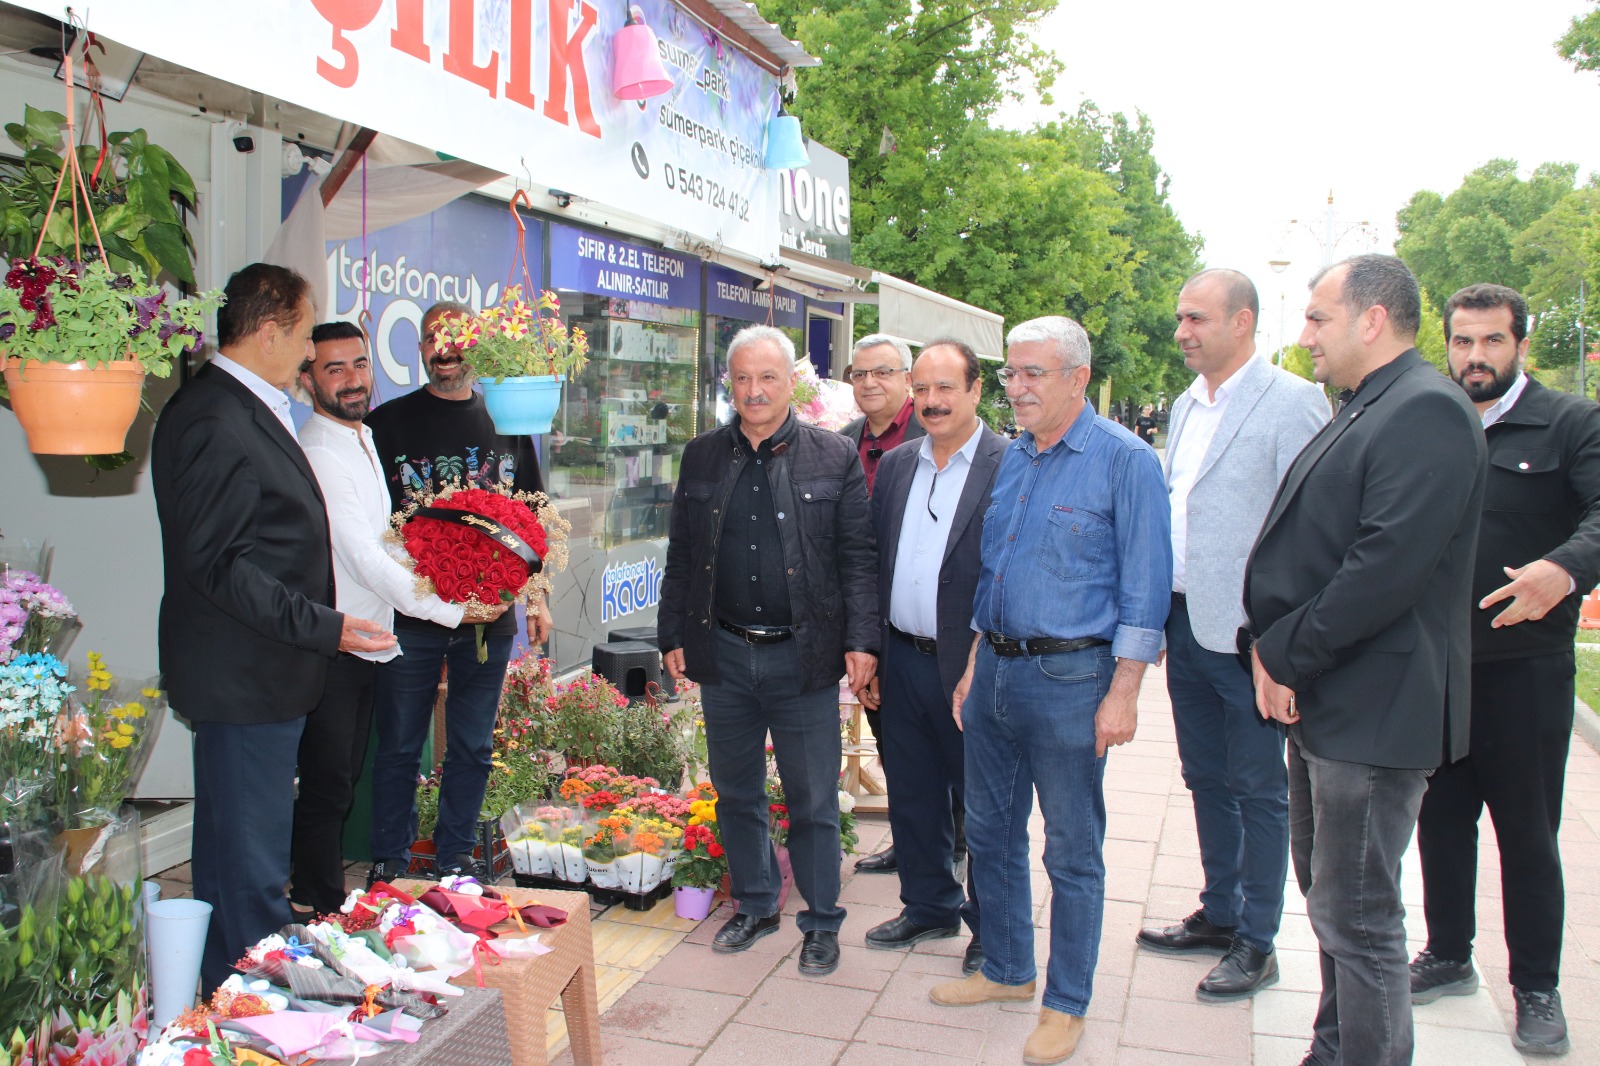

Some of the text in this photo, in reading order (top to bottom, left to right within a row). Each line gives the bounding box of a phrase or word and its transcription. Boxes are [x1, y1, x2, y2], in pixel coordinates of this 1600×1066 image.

[660, 101, 727, 153] sümerpark
[664, 162, 675, 190] 0
[678, 167, 703, 201] 543
[706, 179, 726, 210] 724
[578, 236, 684, 278] SIFIR & 2.EL TELEFON
[800, 231, 828, 258] Servis
[339, 243, 470, 304] telefoncu
[597, 269, 669, 300] ALINIR-SATILIR
[716, 281, 750, 304] TELEFON
[774, 294, 797, 314] YAPILIR
[606, 561, 646, 584] telefoncu
